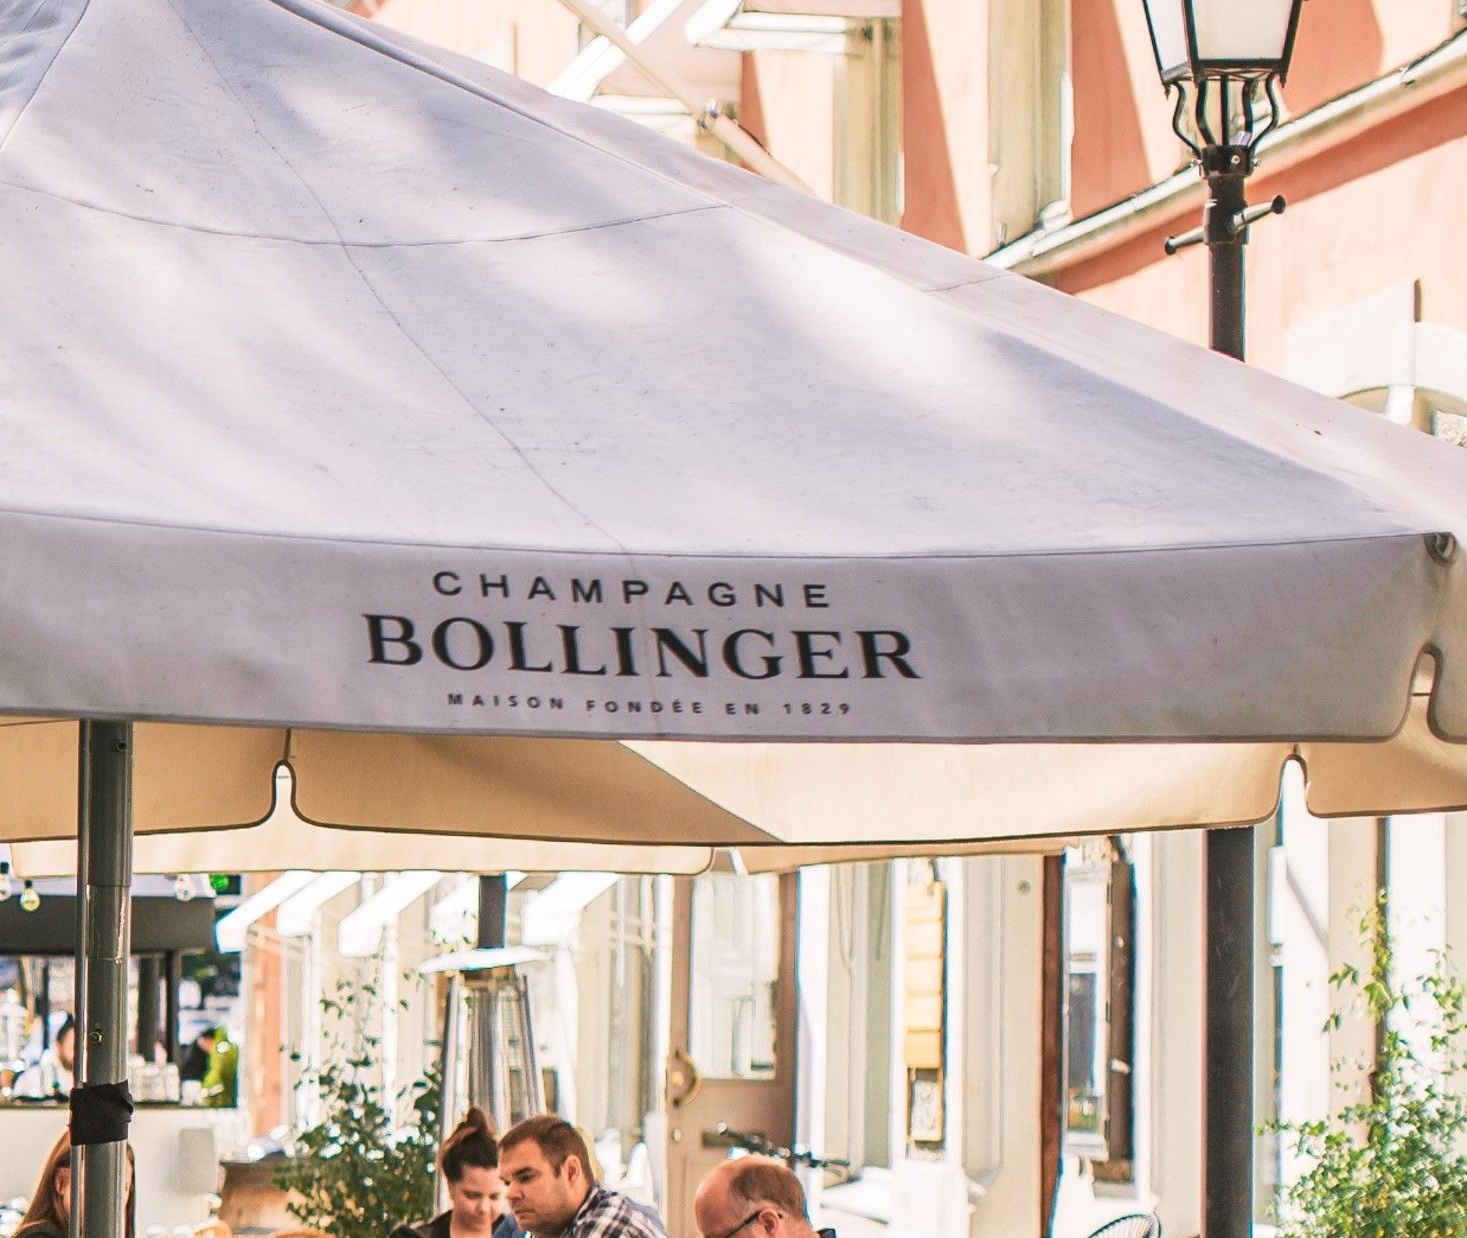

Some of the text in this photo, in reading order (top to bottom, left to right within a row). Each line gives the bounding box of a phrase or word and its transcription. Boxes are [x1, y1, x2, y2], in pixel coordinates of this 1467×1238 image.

[432, 570, 831, 608] CHAMPAGNE
[361, 613, 924, 680] BOLLINGER
[448, 692, 851, 716] MAISON FONDÉE EN 1829
